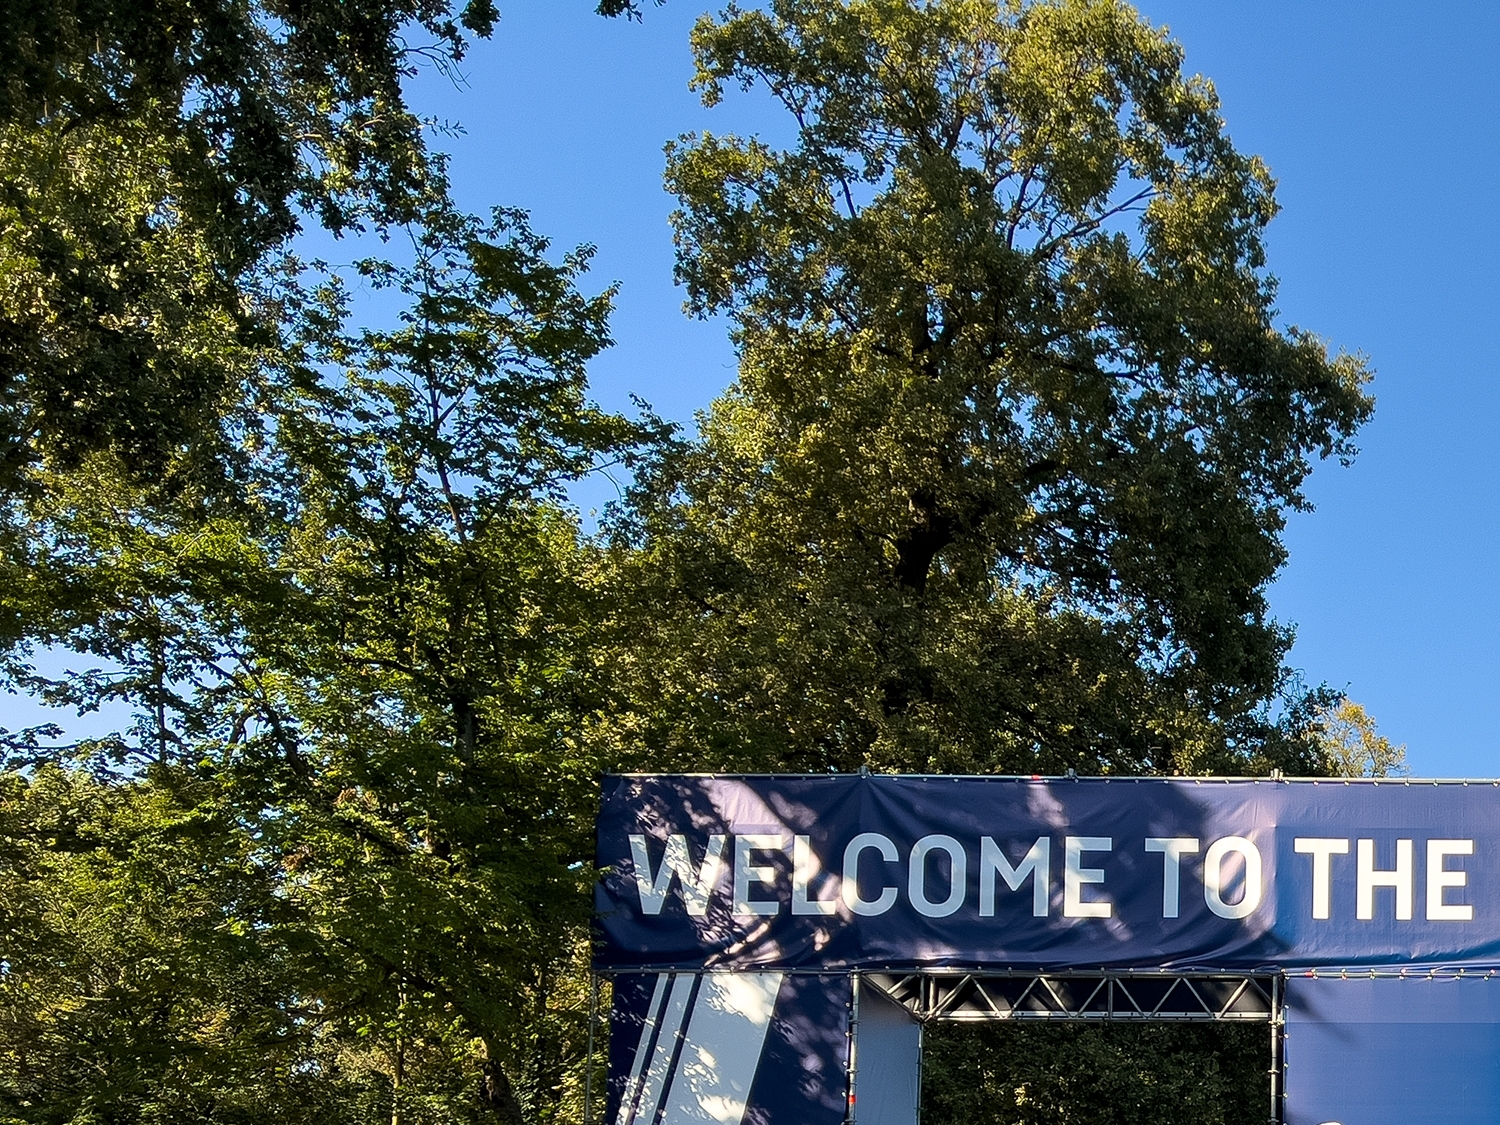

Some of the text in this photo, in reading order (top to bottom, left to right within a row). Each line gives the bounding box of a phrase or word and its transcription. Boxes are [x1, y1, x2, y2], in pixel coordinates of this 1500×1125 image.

[628, 832, 1112, 919] WELCOME
[1144, 835, 1263, 919] TO
[1294, 838, 1474, 921] THE
